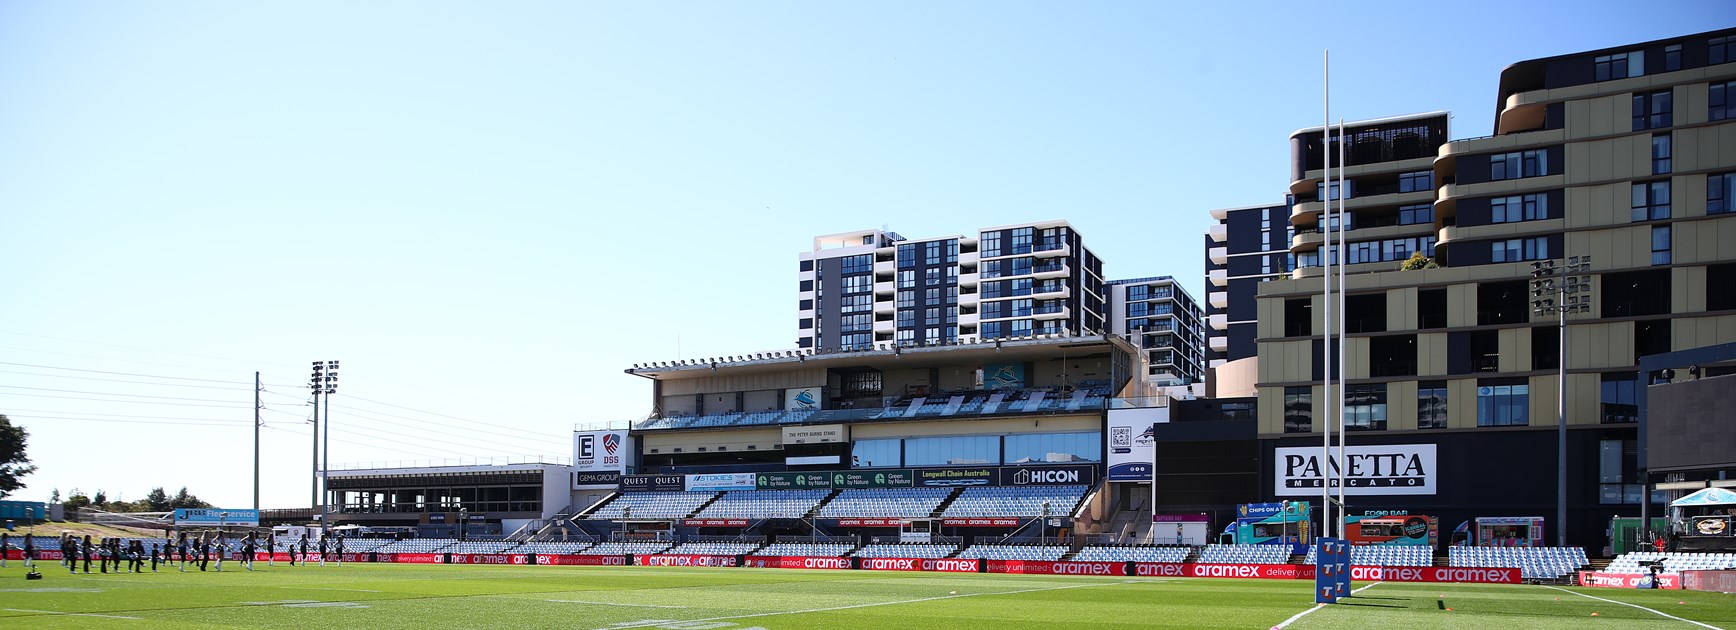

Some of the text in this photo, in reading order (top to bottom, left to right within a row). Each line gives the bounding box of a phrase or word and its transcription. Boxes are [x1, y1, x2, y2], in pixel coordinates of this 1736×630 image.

[581, 438, 591, 456] E
[1285, 454, 1426, 477] PANETTA
[1032, 470, 1078, 483] HICON
[1294, 479, 1416, 487] MERCATO
[1324, 542, 1334, 551] T
[1337, 544, 1344, 552] T
[554, 556, 574, 564] delivery
[862, 558, 912, 570] aramex
[922, 559, 976, 572] aramex
[1012, 563, 1048, 572] unlimited
[1052, 563, 1111, 574] aramex
[1194, 565, 1260, 577] aramex
[1324, 564, 1333, 574] T
[1337, 563, 1344, 571] T
[1266, 568, 1301, 578] delivery
[1351, 567, 1511, 582] aramex aramex
[1323, 587, 1332, 596] T
